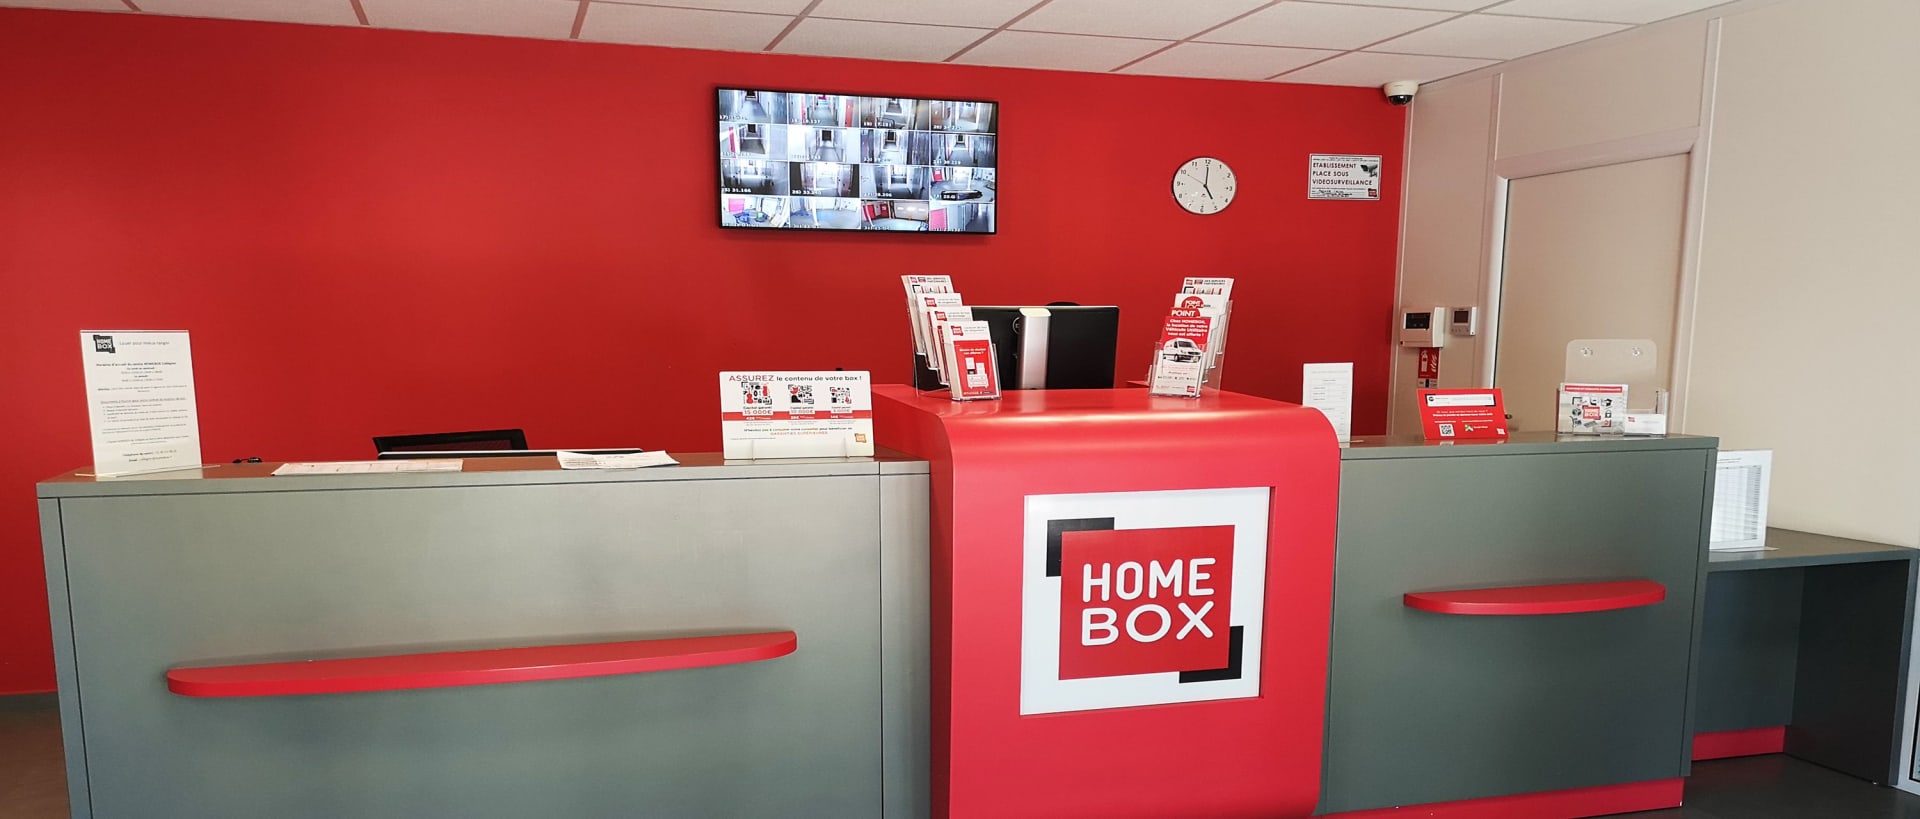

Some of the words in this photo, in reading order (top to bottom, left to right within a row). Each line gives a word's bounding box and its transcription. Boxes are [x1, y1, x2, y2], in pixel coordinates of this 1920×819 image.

[1171, 309, 1196, 317] POINT
[728, 374, 774, 382] ASSUREZ
[1082, 556, 1216, 603] HOME
[1081, 600, 1215, 647] BOX
